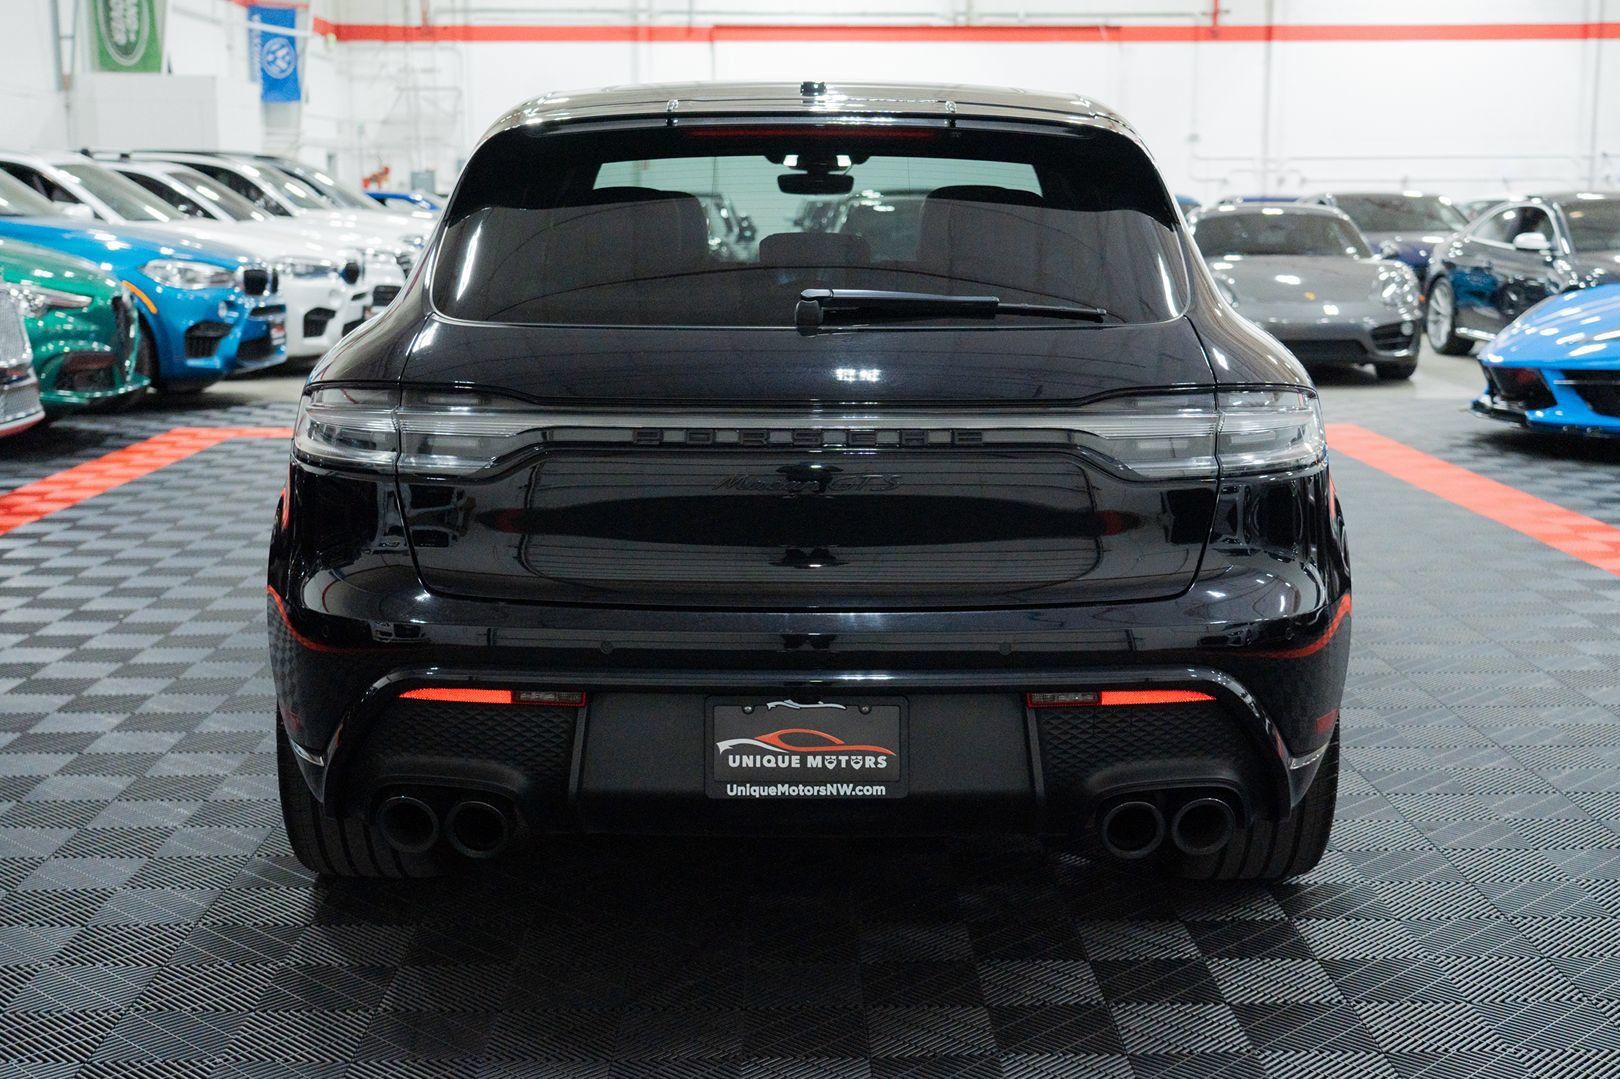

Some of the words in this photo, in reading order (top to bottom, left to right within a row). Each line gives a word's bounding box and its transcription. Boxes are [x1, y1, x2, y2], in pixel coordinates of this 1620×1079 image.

[634, 428, 983, 445] PORSCHE
[828, 474, 901, 492] GTS
[728, 755, 800, 768] UNIQUE
[807, 755, 887, 770] MOTORS
[727, 784, 886, 797] UniqueMotorsNW.com
